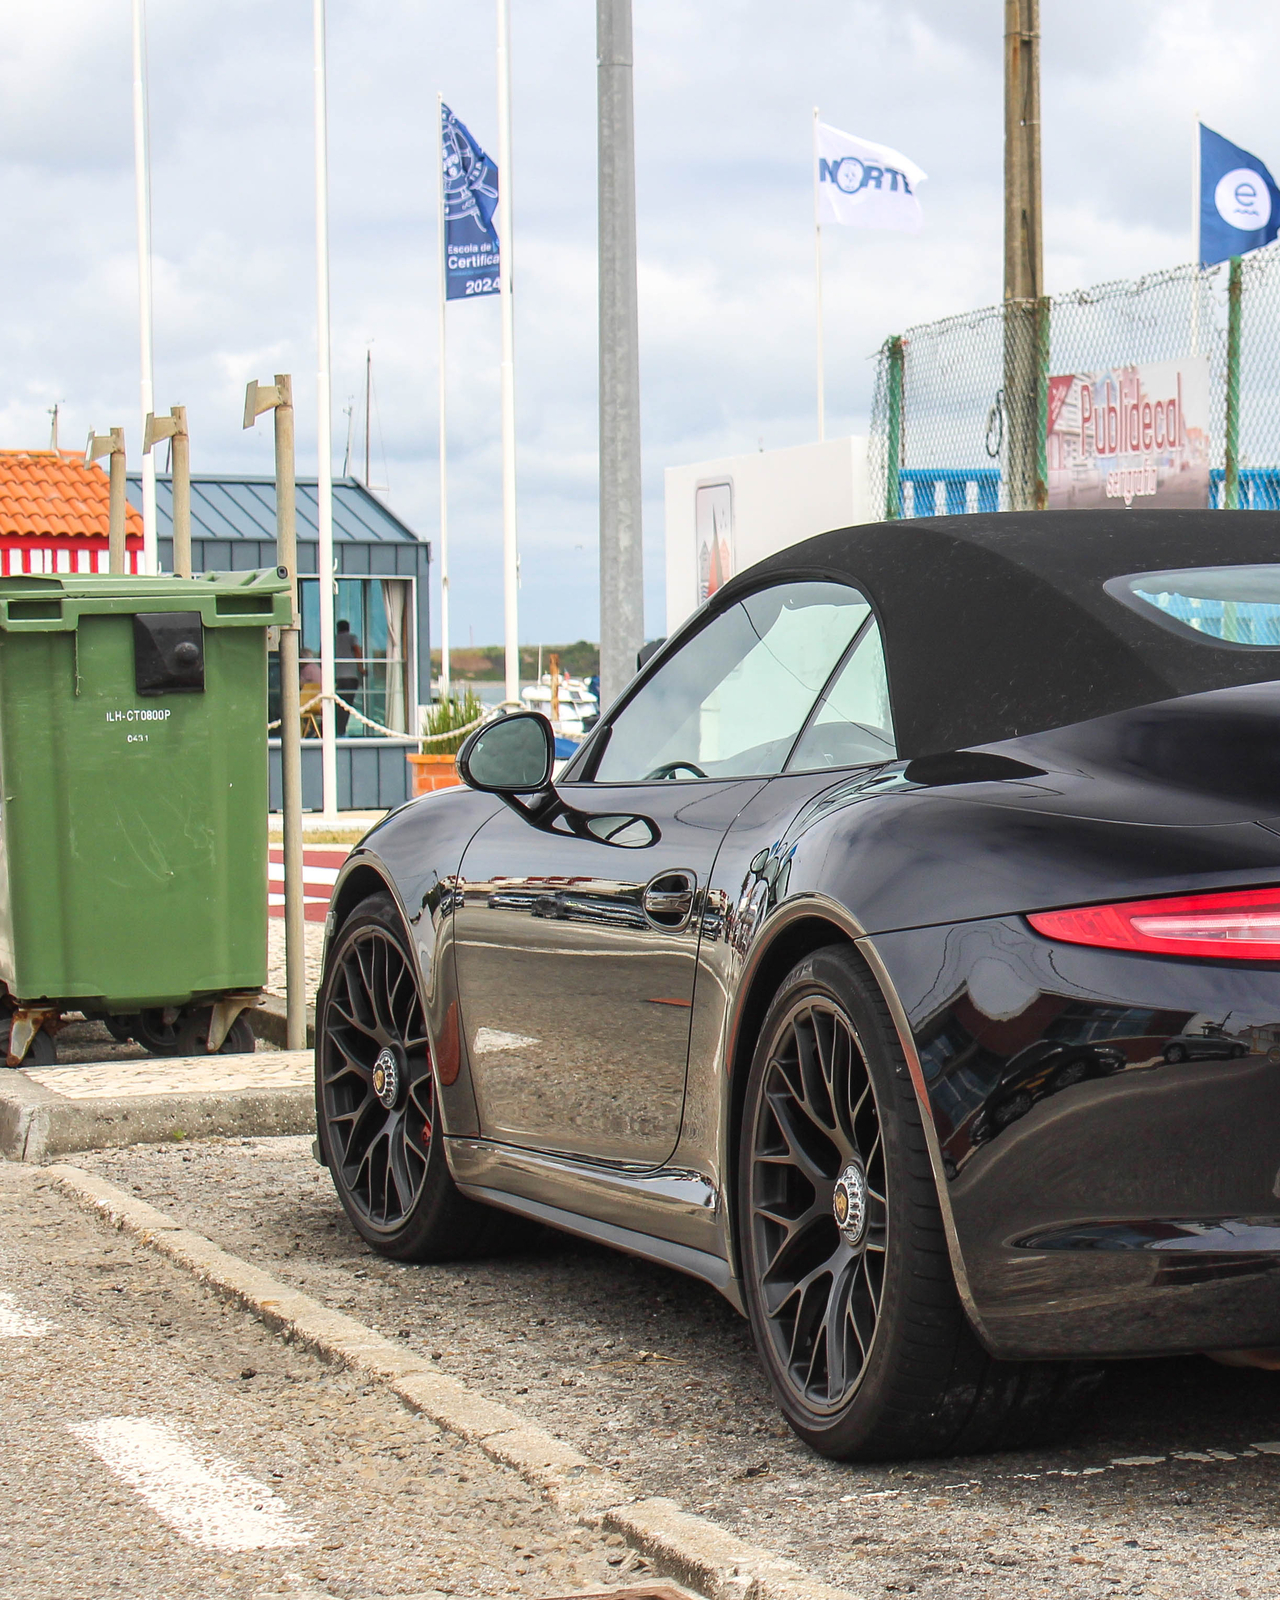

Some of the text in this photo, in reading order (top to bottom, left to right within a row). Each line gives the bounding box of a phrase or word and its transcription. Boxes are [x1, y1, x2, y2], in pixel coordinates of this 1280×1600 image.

[448, 242, 491, 255] Escola de
[465, 277, 500, 296] 2024
[1080, 371, 1182, 457] Publidecal
